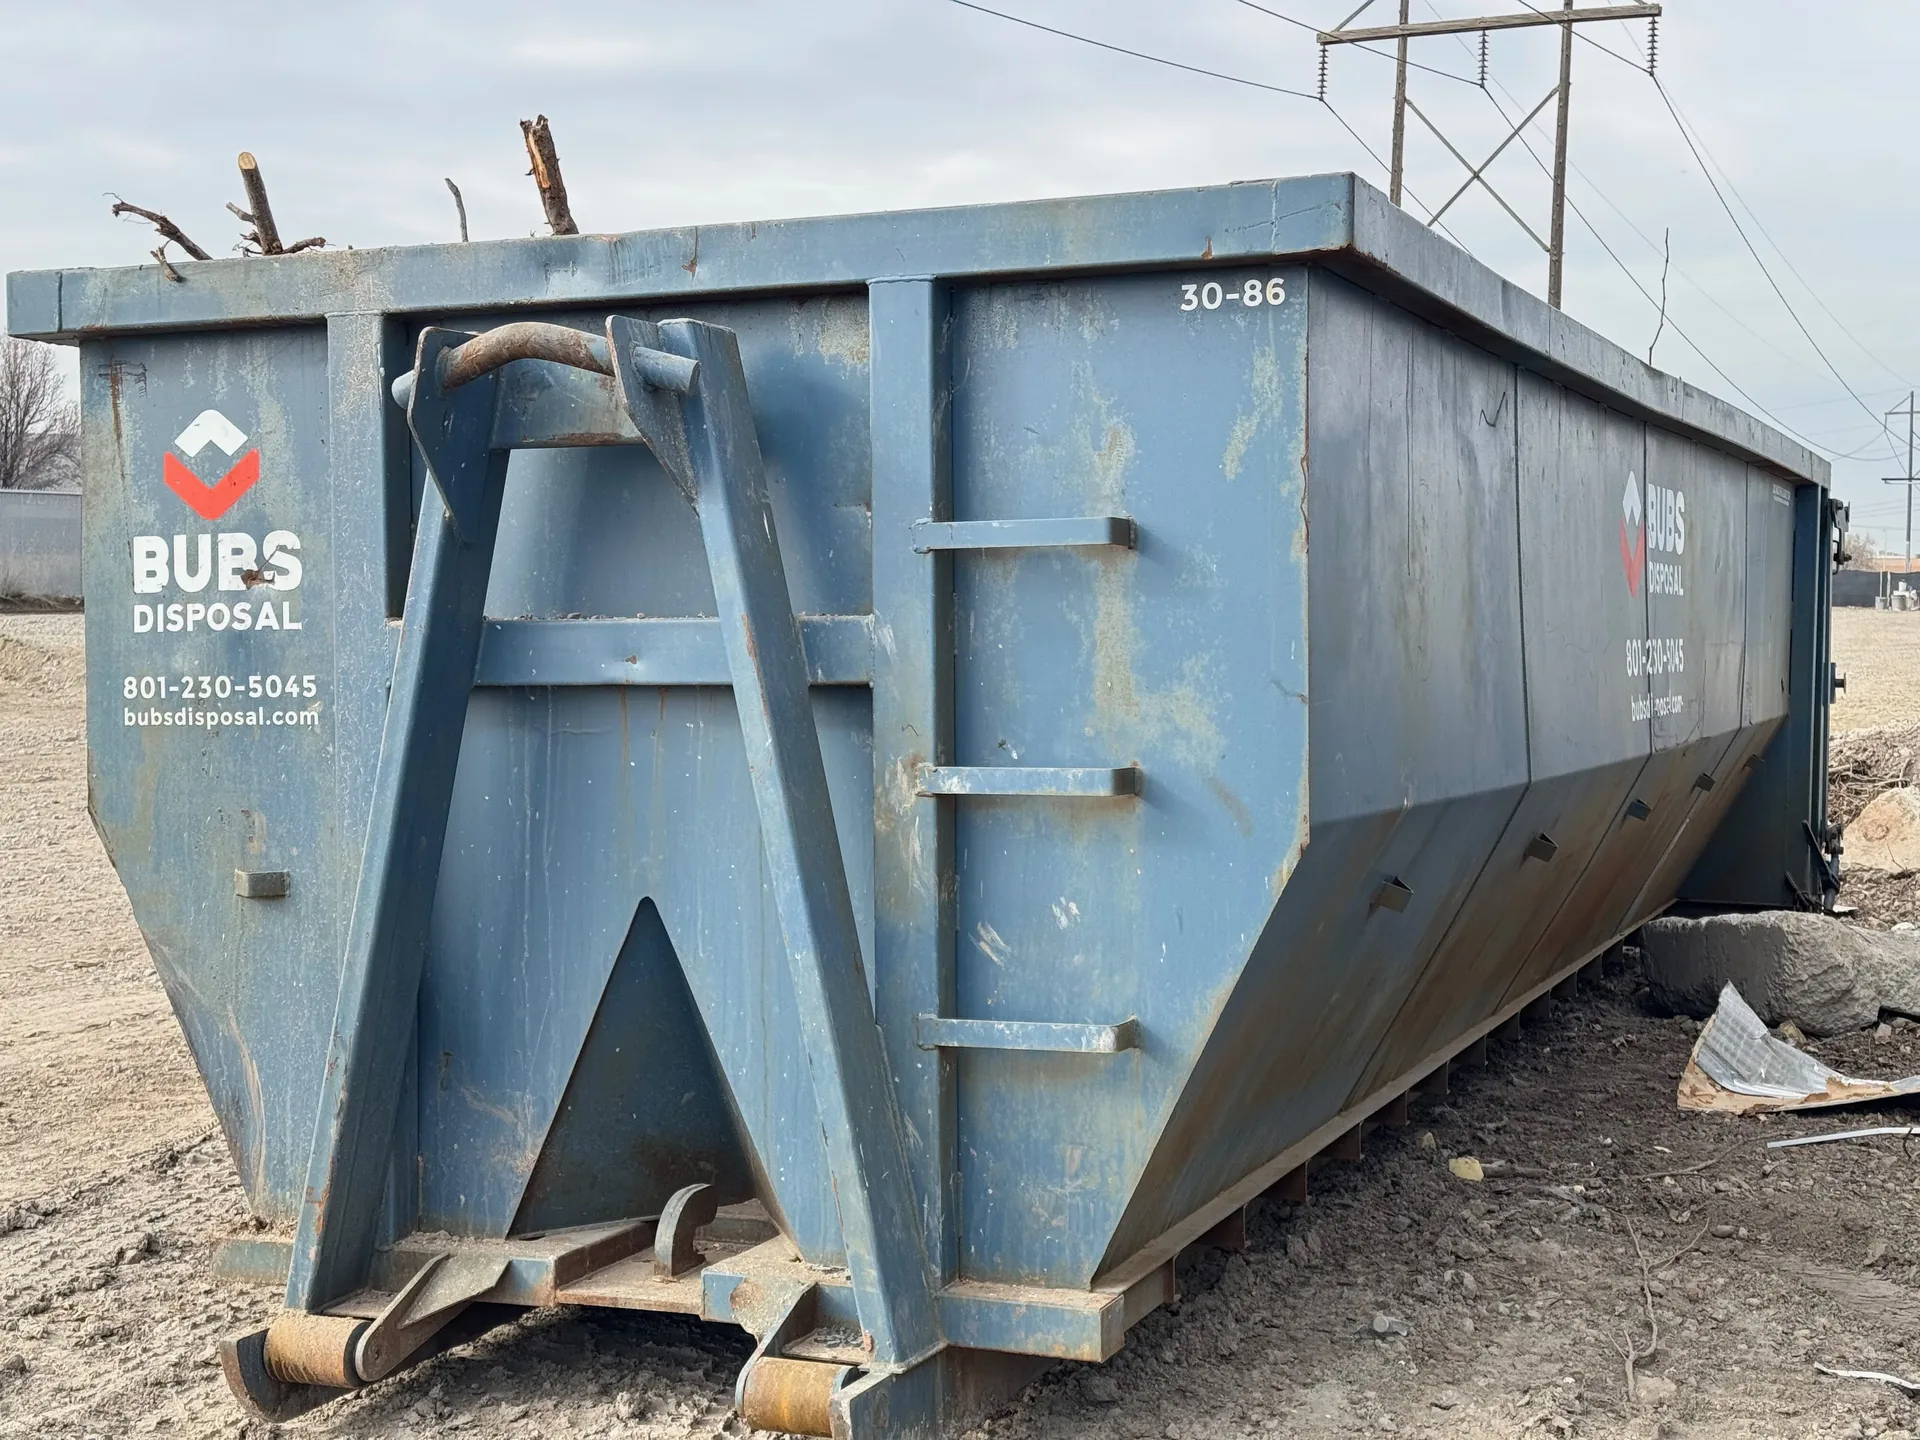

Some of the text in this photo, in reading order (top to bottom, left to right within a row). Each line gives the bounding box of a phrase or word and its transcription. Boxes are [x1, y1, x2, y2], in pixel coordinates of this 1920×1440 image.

[1180, 277, 1286, 311] 30-86
[1648, 483, 1685, 556] BUBS
[133, 530, 303, 593] BUBS
[1649, 561, 1684, 596] DISPOSAL
[133, 601, 303, 633] DISPOSAL
[1626, 638, 1684, 677] 801-230-5045
[123, 674, 318, 700] 801-230-5045
[123, 707, 320, 729] bubsdisposal.com
